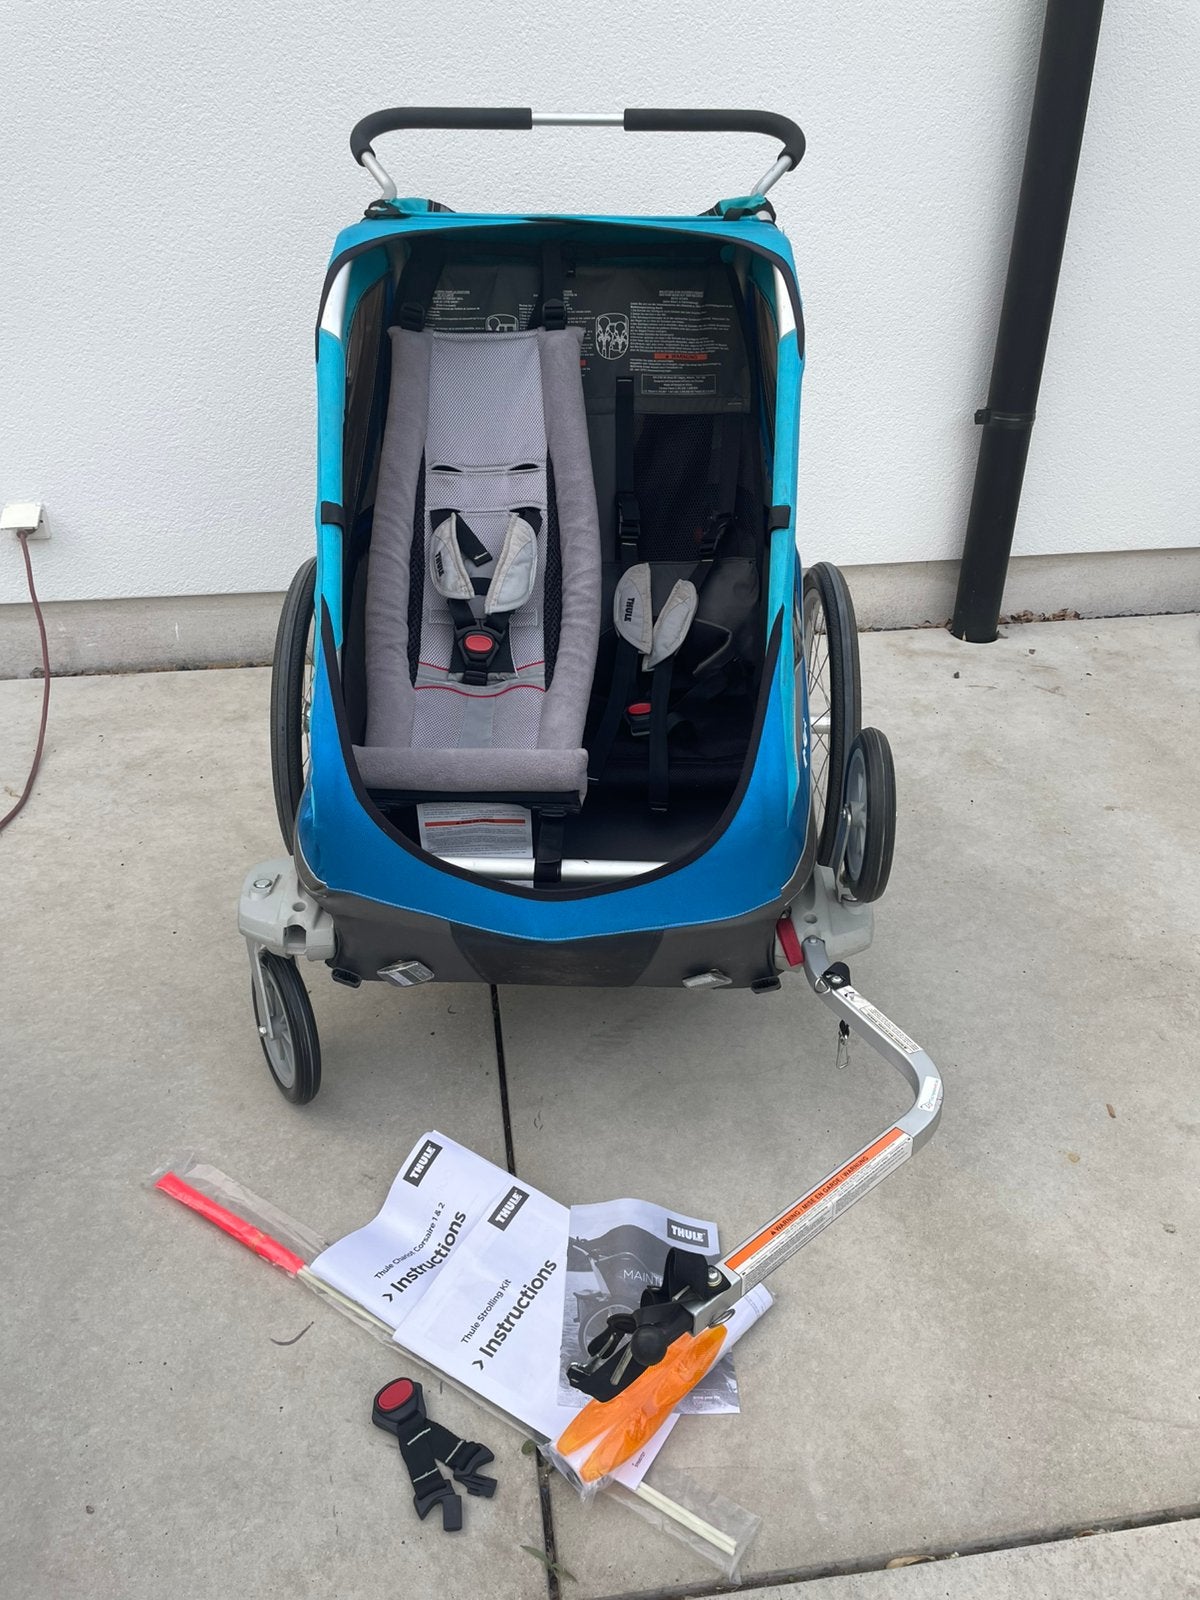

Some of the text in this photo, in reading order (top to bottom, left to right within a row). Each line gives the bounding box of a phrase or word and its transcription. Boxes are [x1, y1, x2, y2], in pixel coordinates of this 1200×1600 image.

[435, 551, 444, 577] THULE
[624, 597, 635, 622] THULE
[409, 1144, 437, 1180] THULE
[494, 1191, 523, 1224] THULE
[775, 1211, 801, 1232] WARNING
[801, 1198, 816, 1210] MISE
[814, 1192, 823, 1201] EN
[822, 1178, 841, 1193] GARDE
[374, 1262, 395, 1280] Thule
[392, 1250, 415, 1265] Chariot
[413, 1222, 436, 1253] Corsaire
[434, 1209, 442, 1217] &
[438, 1201, 445, 1210] 2
[390, 1211, 467, 1293] Instructions
[670, 1224, 705, 1243] THULE
[460, 1278, 512, 1344] Thule Strolling Kit
[479, 1259, 557, 1359] Instructions
